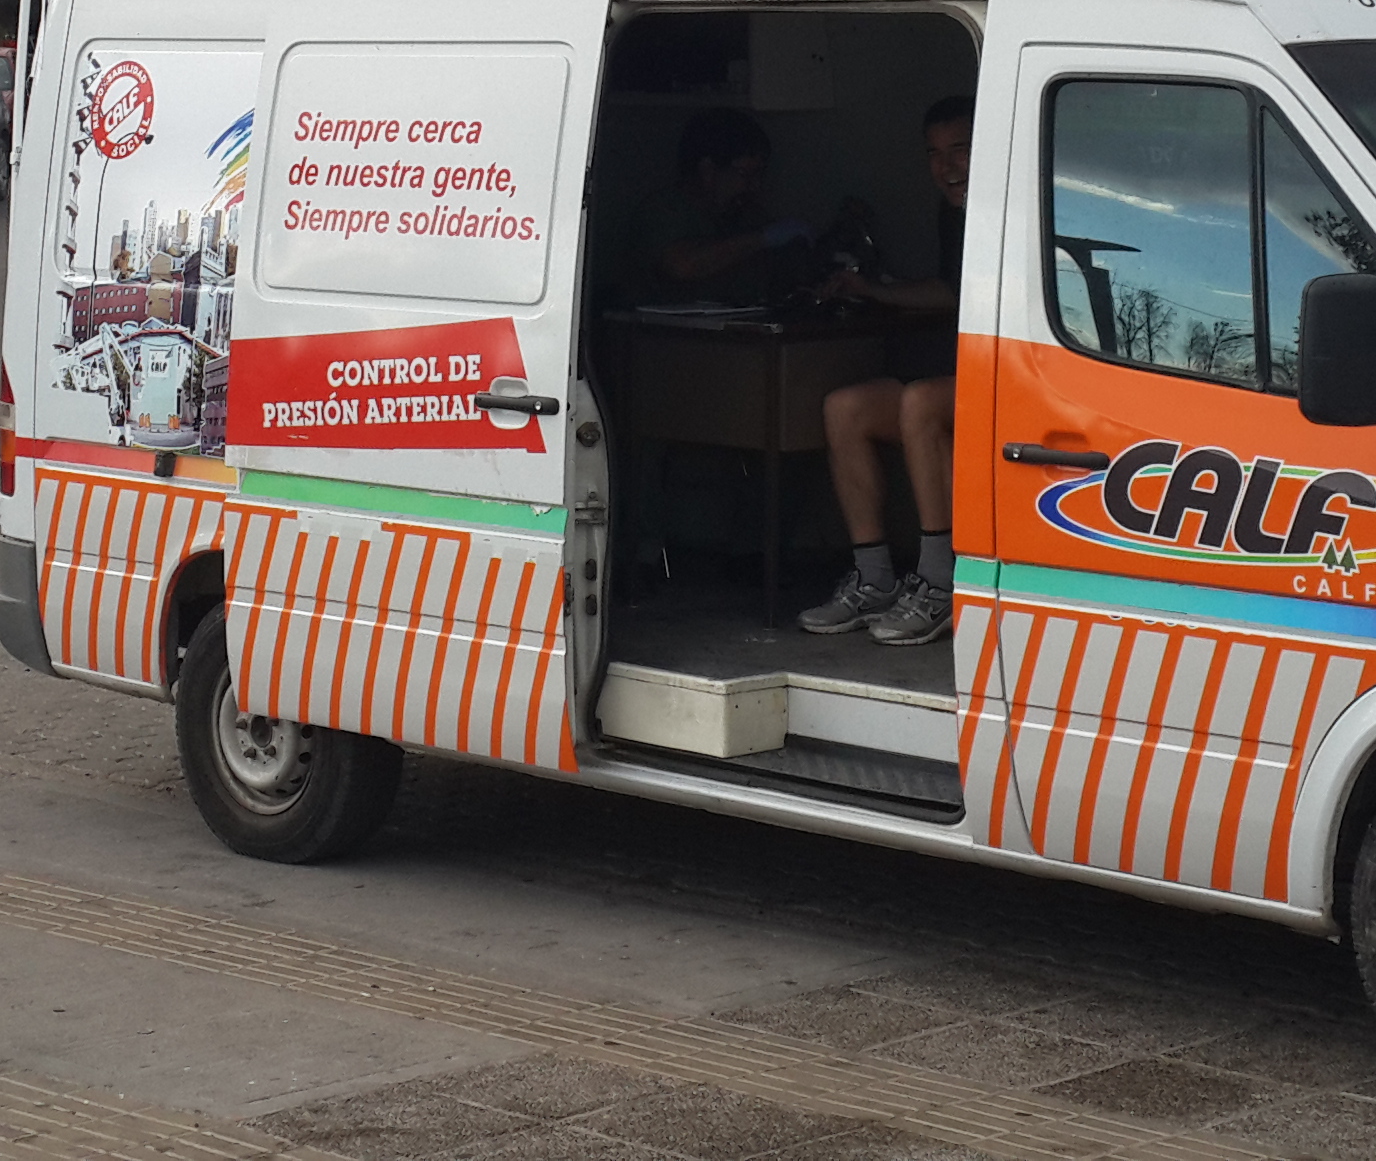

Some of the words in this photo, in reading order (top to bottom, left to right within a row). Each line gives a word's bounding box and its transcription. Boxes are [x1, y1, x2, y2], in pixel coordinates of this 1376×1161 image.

[105, 86, 140, 133] CALF
[111, 117, 151, 157] SOCIAL
[294, 111, 400, 149] Siempre
[407, 119, 482, 144] cerca
[288, 156, 319, 186] de
[325, 160, 426, 189] nuestra
[431, 162, 517, 198] gente,
[284, 200, 390, 240] Siempre
[397, 205, 541, 241] solidarios.
[327, 357, 442, 387] CONTROL
[448, 354, 481, 381] DE
[262, 392, 359, 428] PRESIÓN
[364, 394, 481, 424] ARTERIAL
[1292, 575, 1376, 602] CALF
